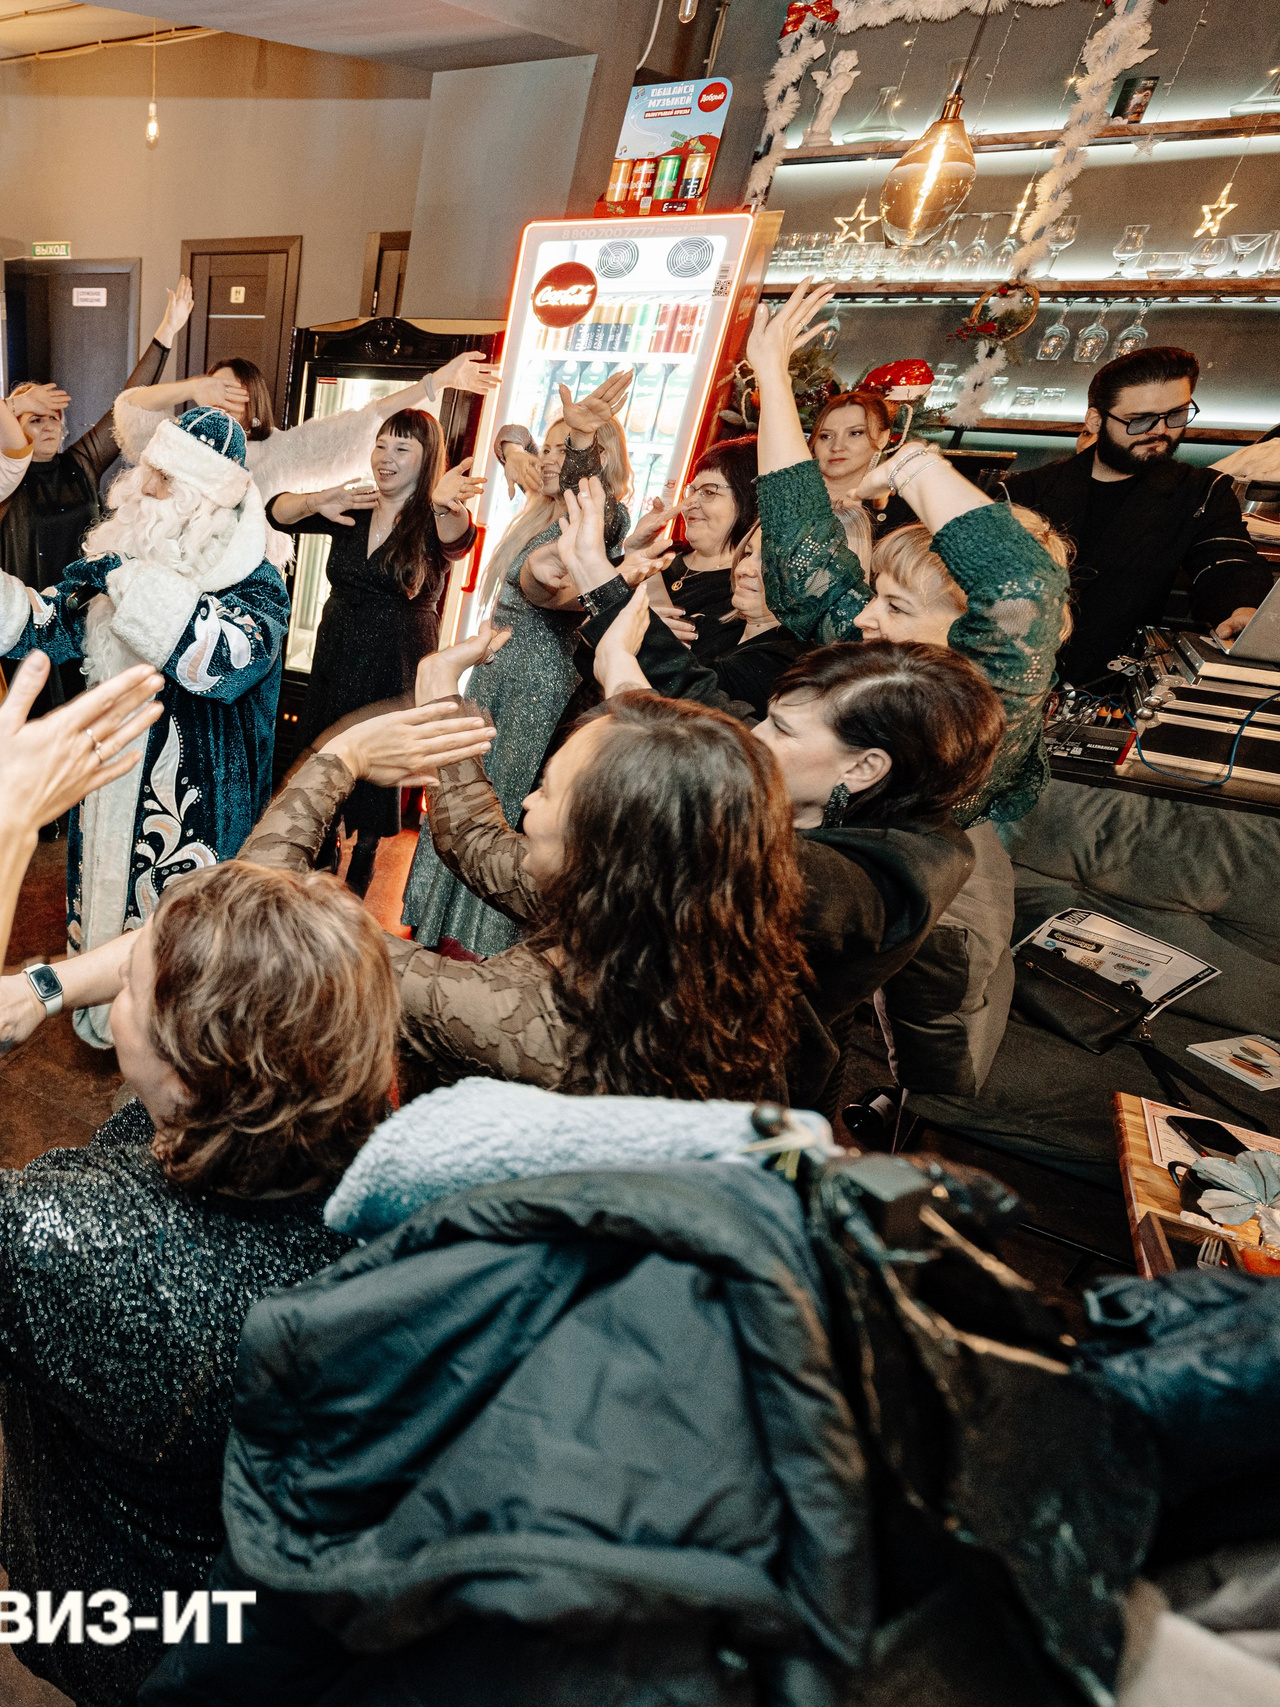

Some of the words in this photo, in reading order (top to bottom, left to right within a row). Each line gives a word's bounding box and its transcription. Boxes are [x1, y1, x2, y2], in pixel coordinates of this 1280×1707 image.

[648, 93, 693, 108] МУЗЫКОЙ
[700, 92, 725, 103] Добрый
[571, 228, 596, 239] 800
[599, 227, 622, 238] 700
[624, 226, 655, 237] 7777
[35, 245, 67, 256] ВЫХОД
